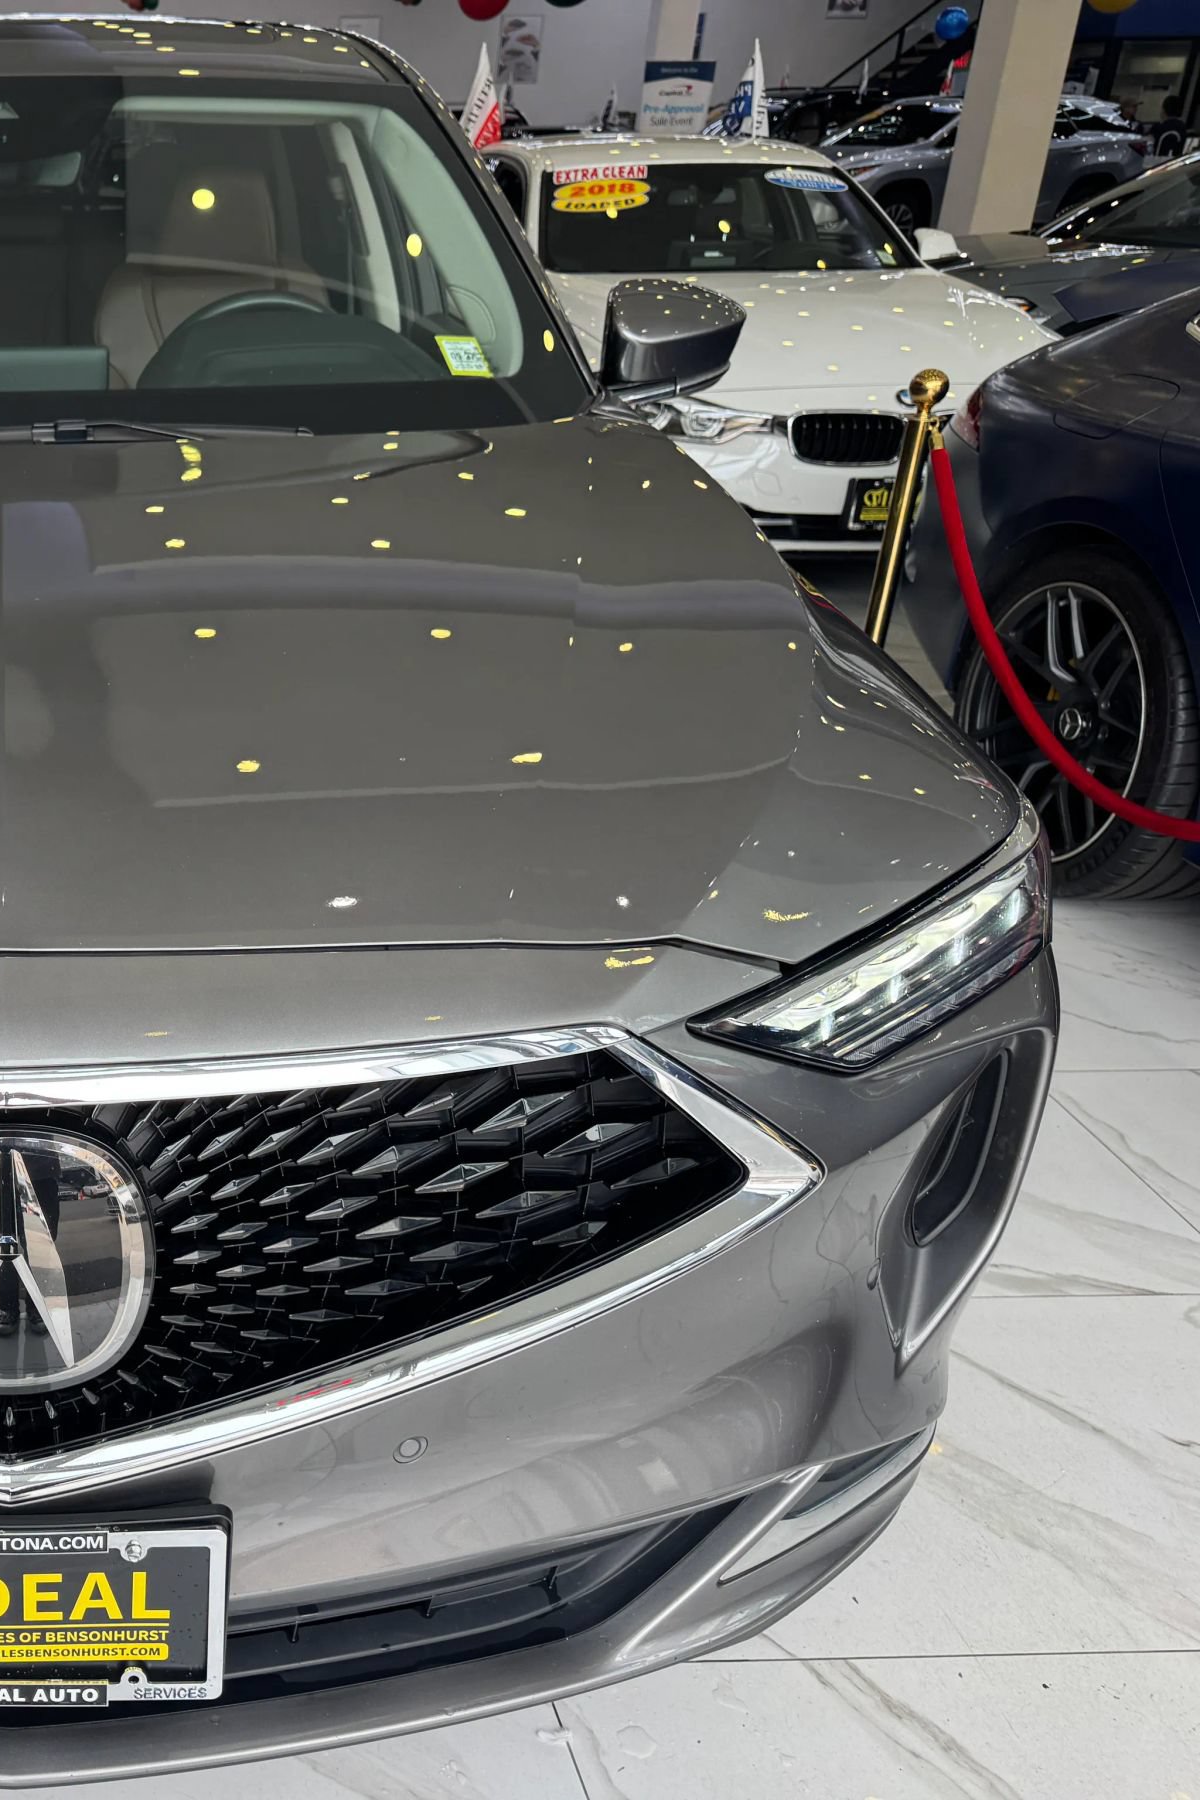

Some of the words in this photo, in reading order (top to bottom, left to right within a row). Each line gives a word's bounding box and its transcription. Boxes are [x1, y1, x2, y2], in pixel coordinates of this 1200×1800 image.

[556, 168, 598, 184] EXTRA
[602, 165, 646, 179] CLEAN
[570, 182, 636, 198] 2018
[565, 198, 635, 209] LOADED
[19, 1631, 42, 1643] OF
[45, 1630, 170, 1642] BENSONHURST
[32, 1687, 100, 1703] AUTO
[133, 1687, 208, 1700] SERVICES
